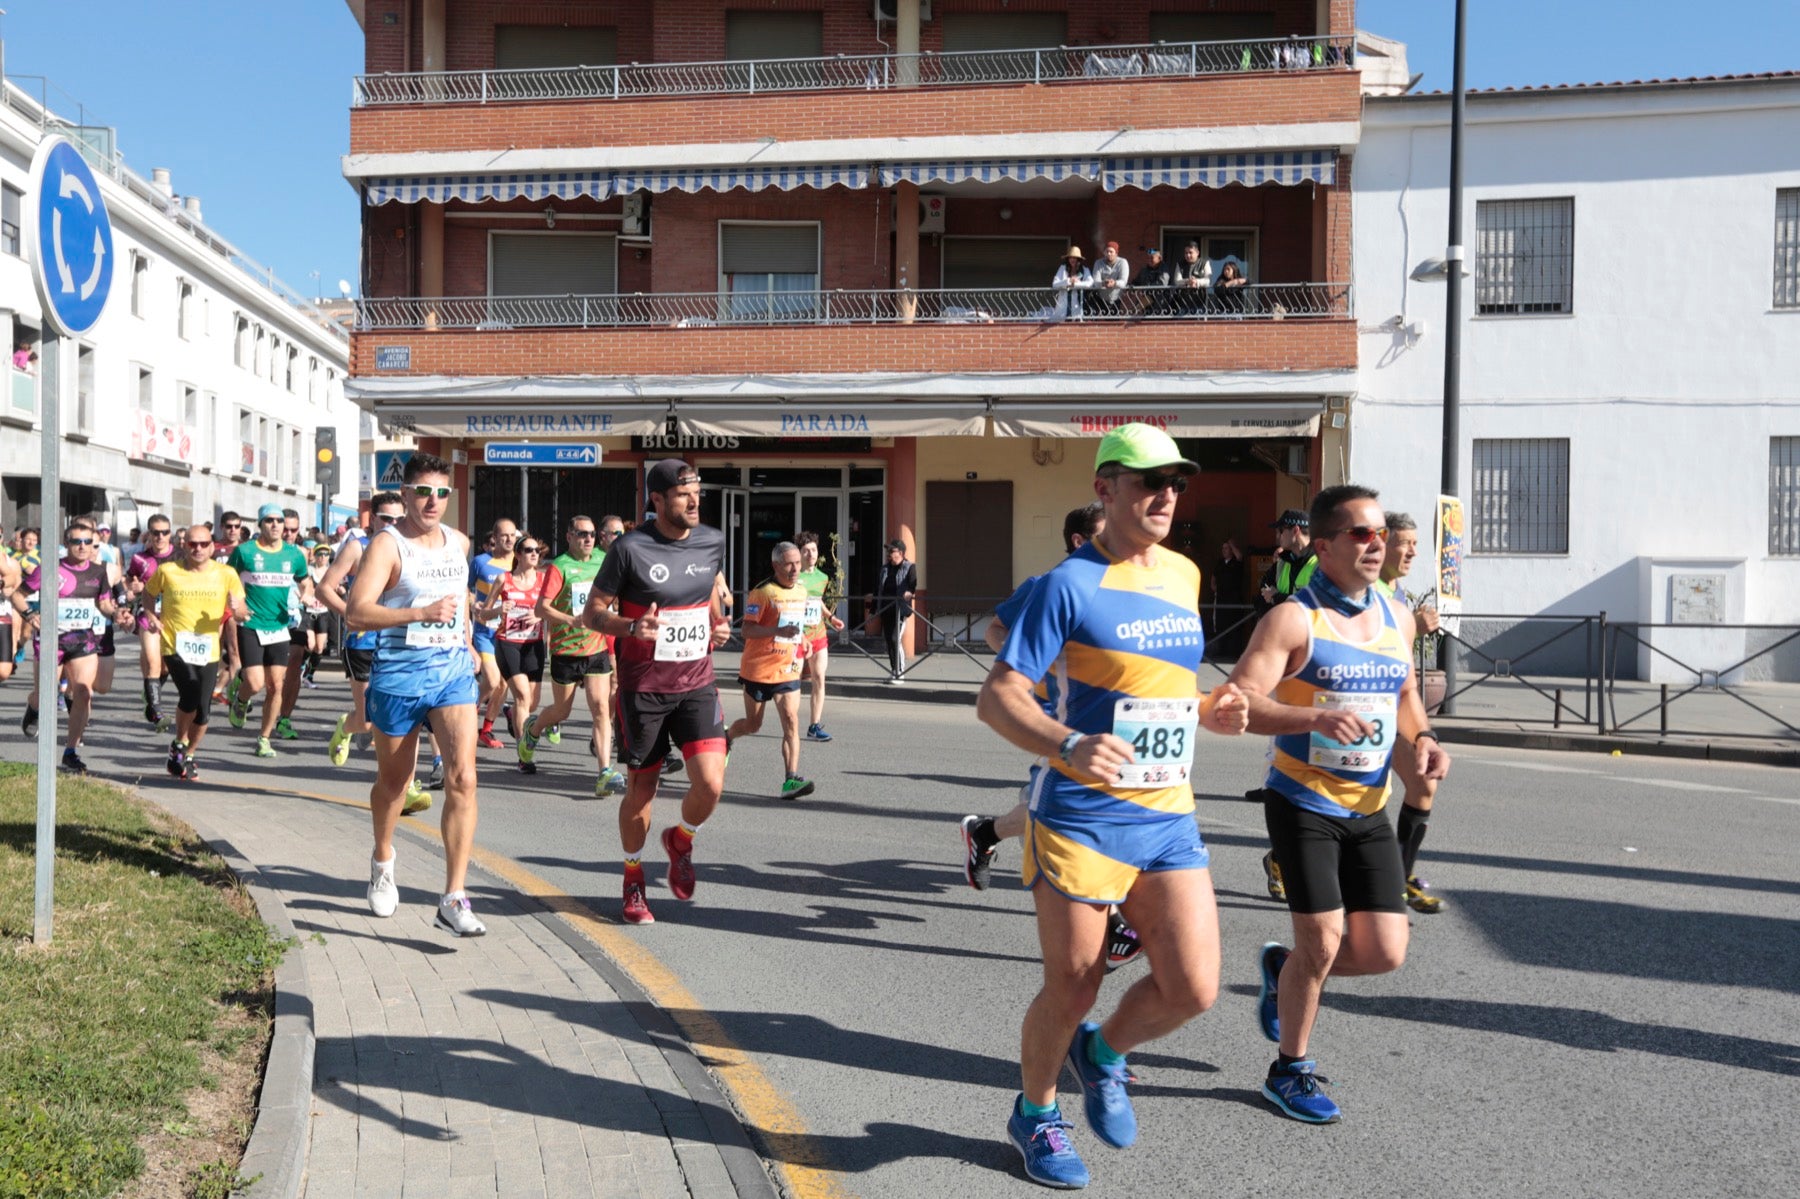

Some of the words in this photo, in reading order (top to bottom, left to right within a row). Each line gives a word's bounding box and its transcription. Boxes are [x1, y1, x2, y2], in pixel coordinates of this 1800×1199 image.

[930, 210, 941, 218] LG
[466, 414, 613, 433] RESTAURANTE
[781, 414, 870, 432] PARADA
[488, 449, 533, 459] Granada
[557, 450, 579, 458] A-44
[65, 608, 90, 620] 228
[665, 624, 706, 643] 3043
[1116, 613, 1202, 641] agustinos
[183, 641, 206, 655] 506
[1137, 636, 1199, 651] GRANADA
[1316, 660, 1408, 683] agustinos
[1332, 682, 1395, 690] GRANADA
[1131, 727, 1185, 759] 483
